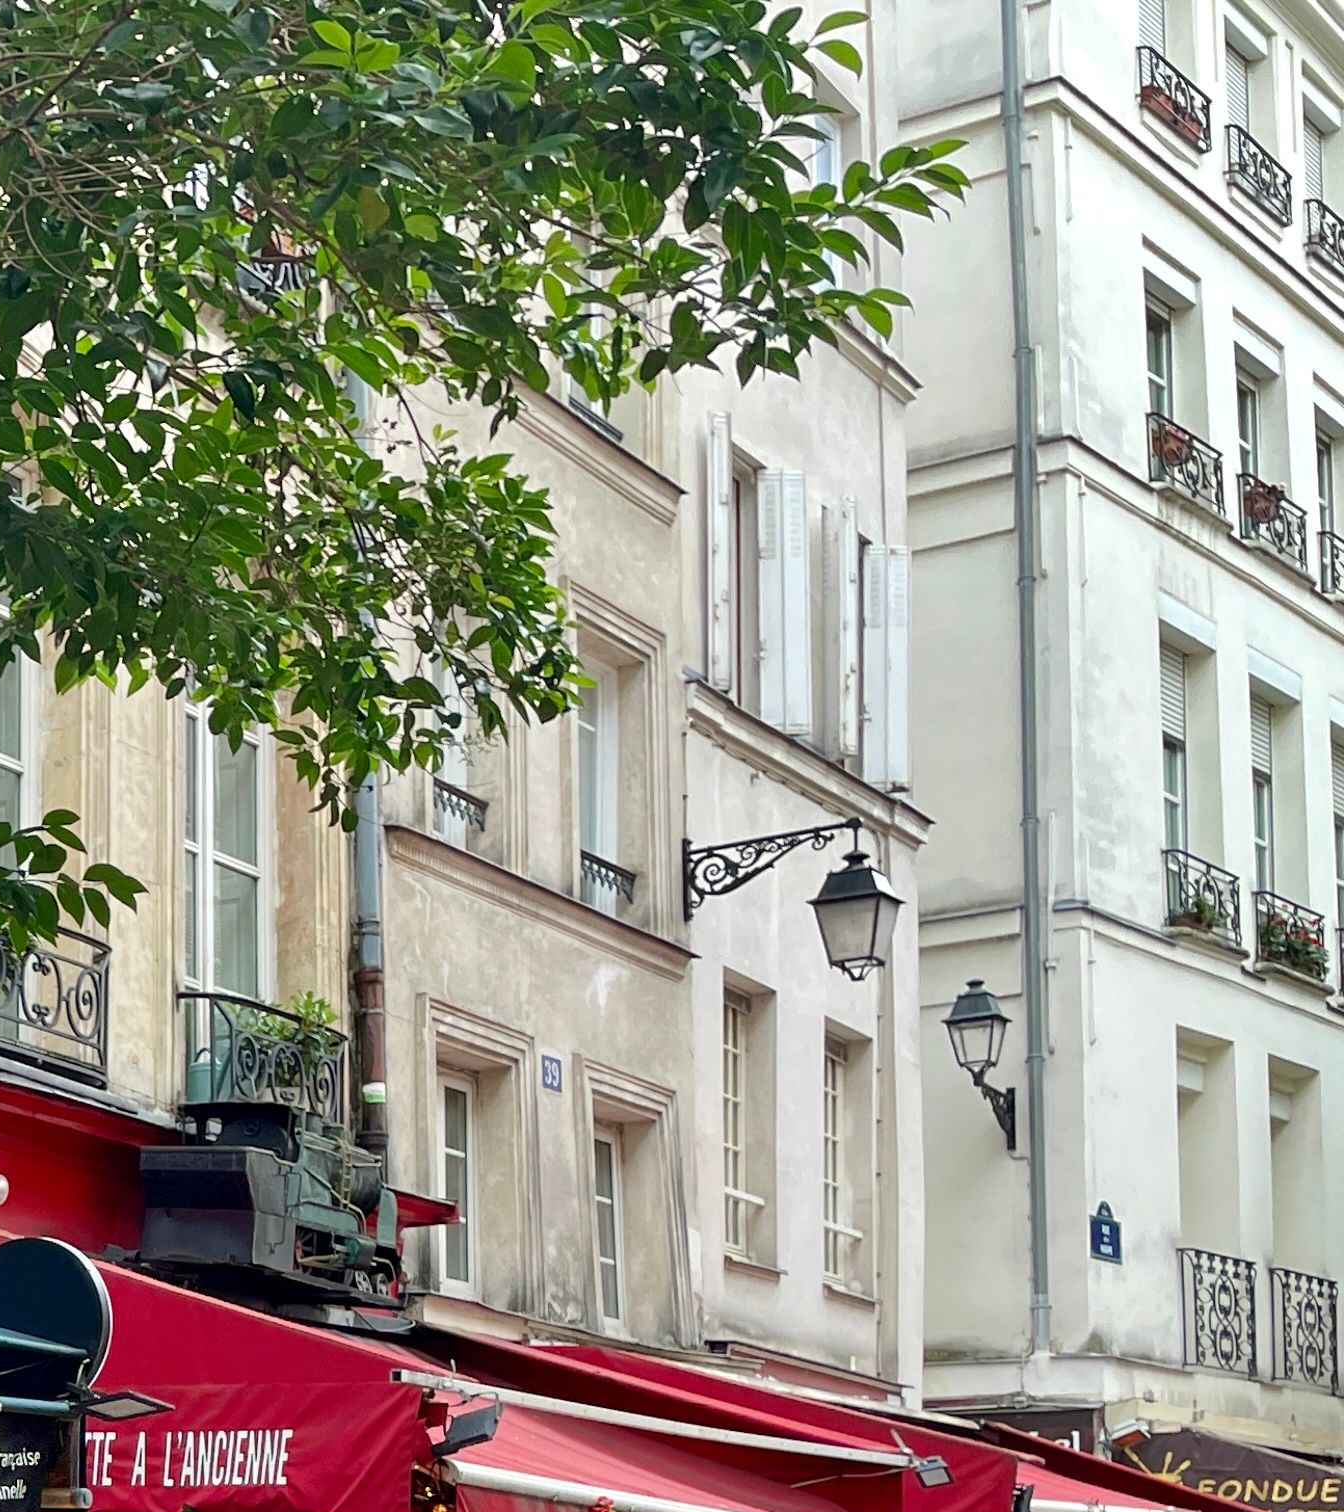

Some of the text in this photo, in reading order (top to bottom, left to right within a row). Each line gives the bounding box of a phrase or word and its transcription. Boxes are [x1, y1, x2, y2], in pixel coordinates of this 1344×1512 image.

[544, 1060, 560, 1087] 39
[131, 1431, 146, 1487] A
[163, 1429, 293, 1488] L'ANCIENNE
[1198, 1478, 1341, 1503] FONDUE
